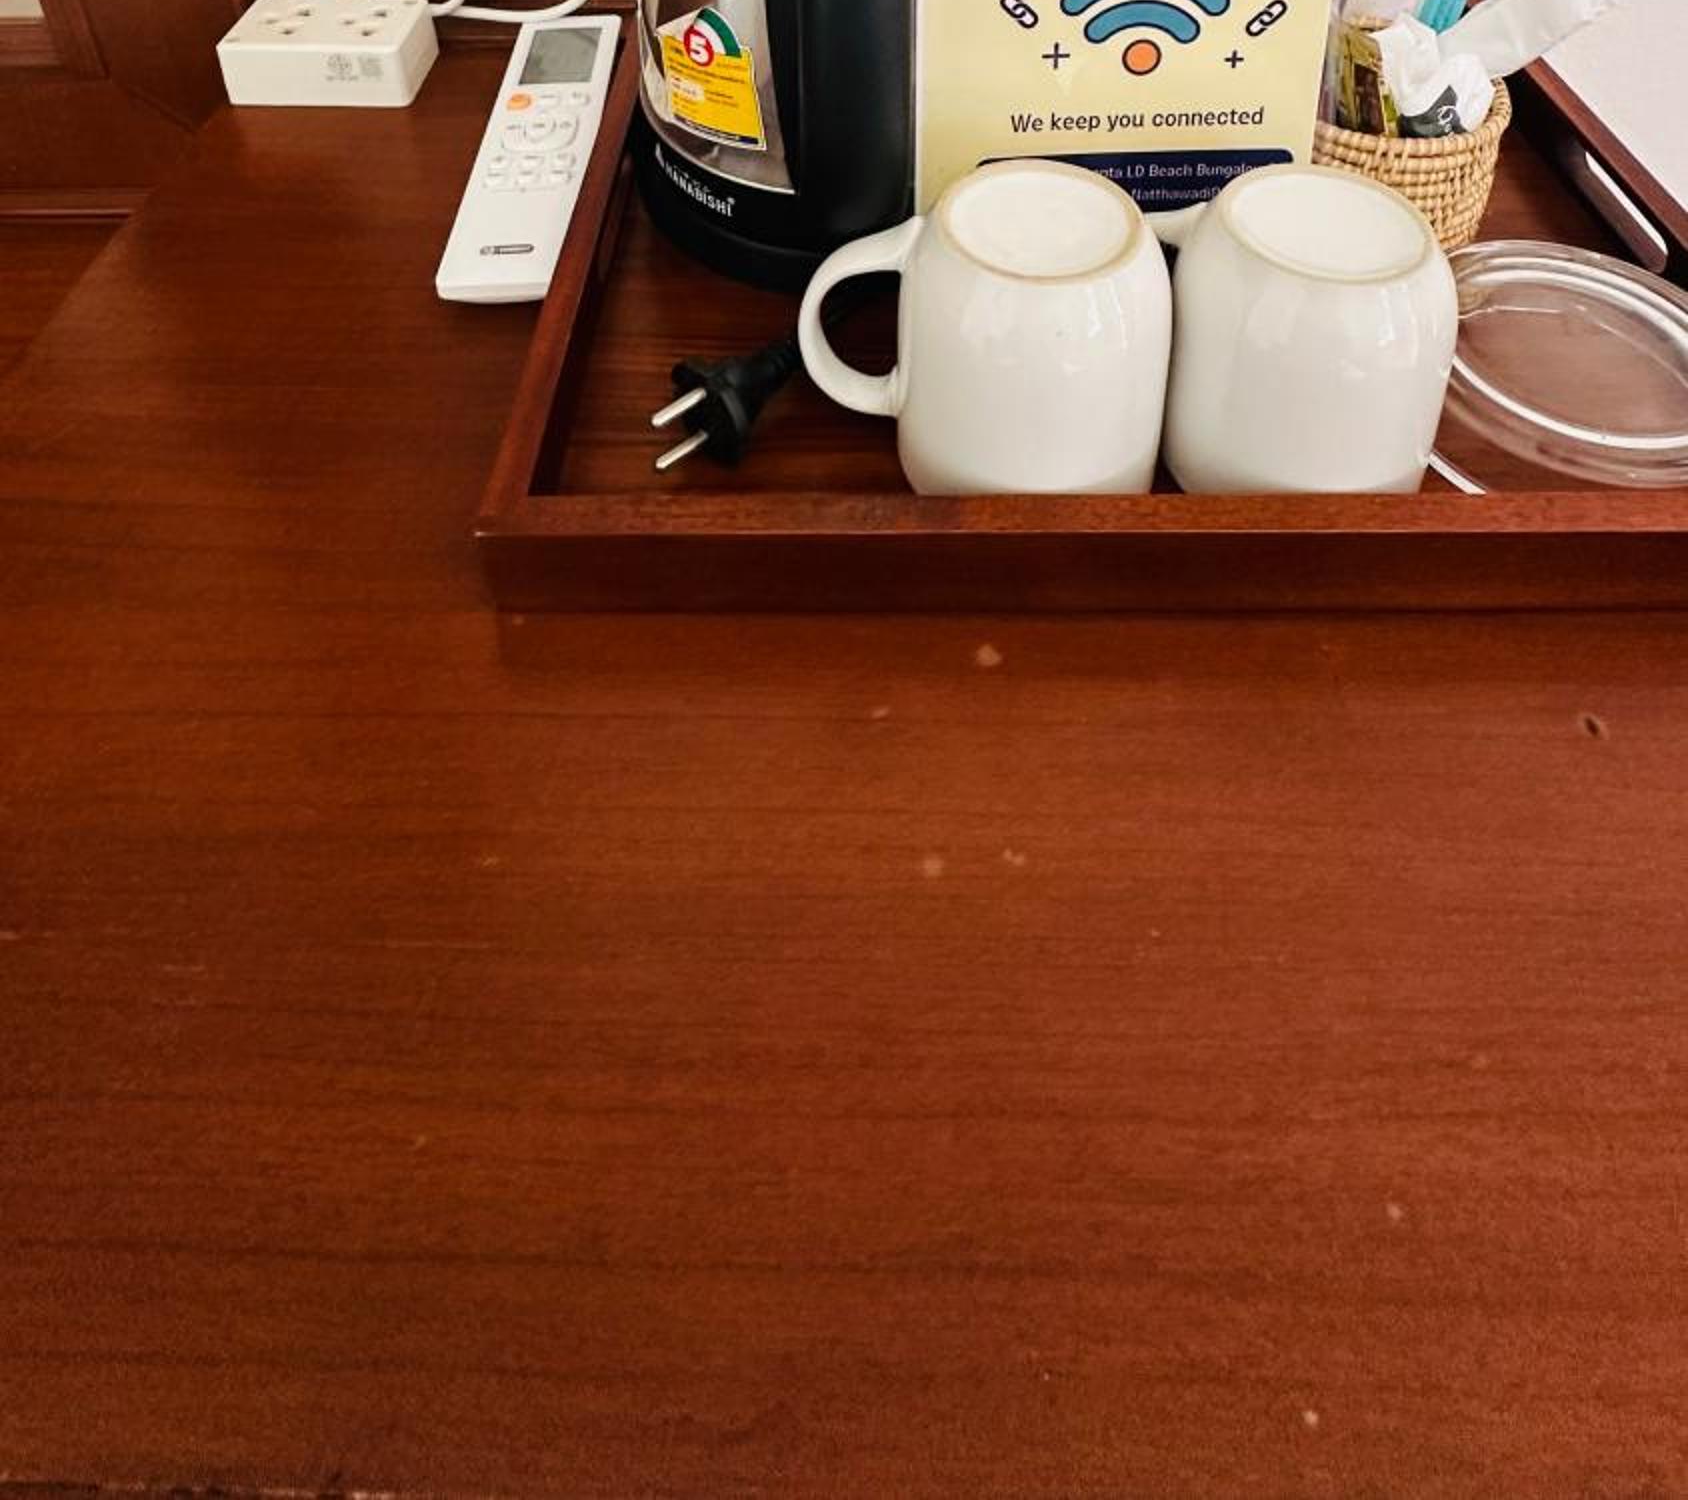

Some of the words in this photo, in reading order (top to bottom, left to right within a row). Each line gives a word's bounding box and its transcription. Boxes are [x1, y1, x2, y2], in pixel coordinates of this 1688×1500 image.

[689, 34, 709, 66] 5
[1010, 114, 1044, 133] We
[1050, 112, 1101, 132] keep
[1107, 113, 1145, 132] you
[1151, 106, 1265, 128] connected
[1126, 165, 1145, 178] LD
[1149, 163, 1193, 177] Beach
